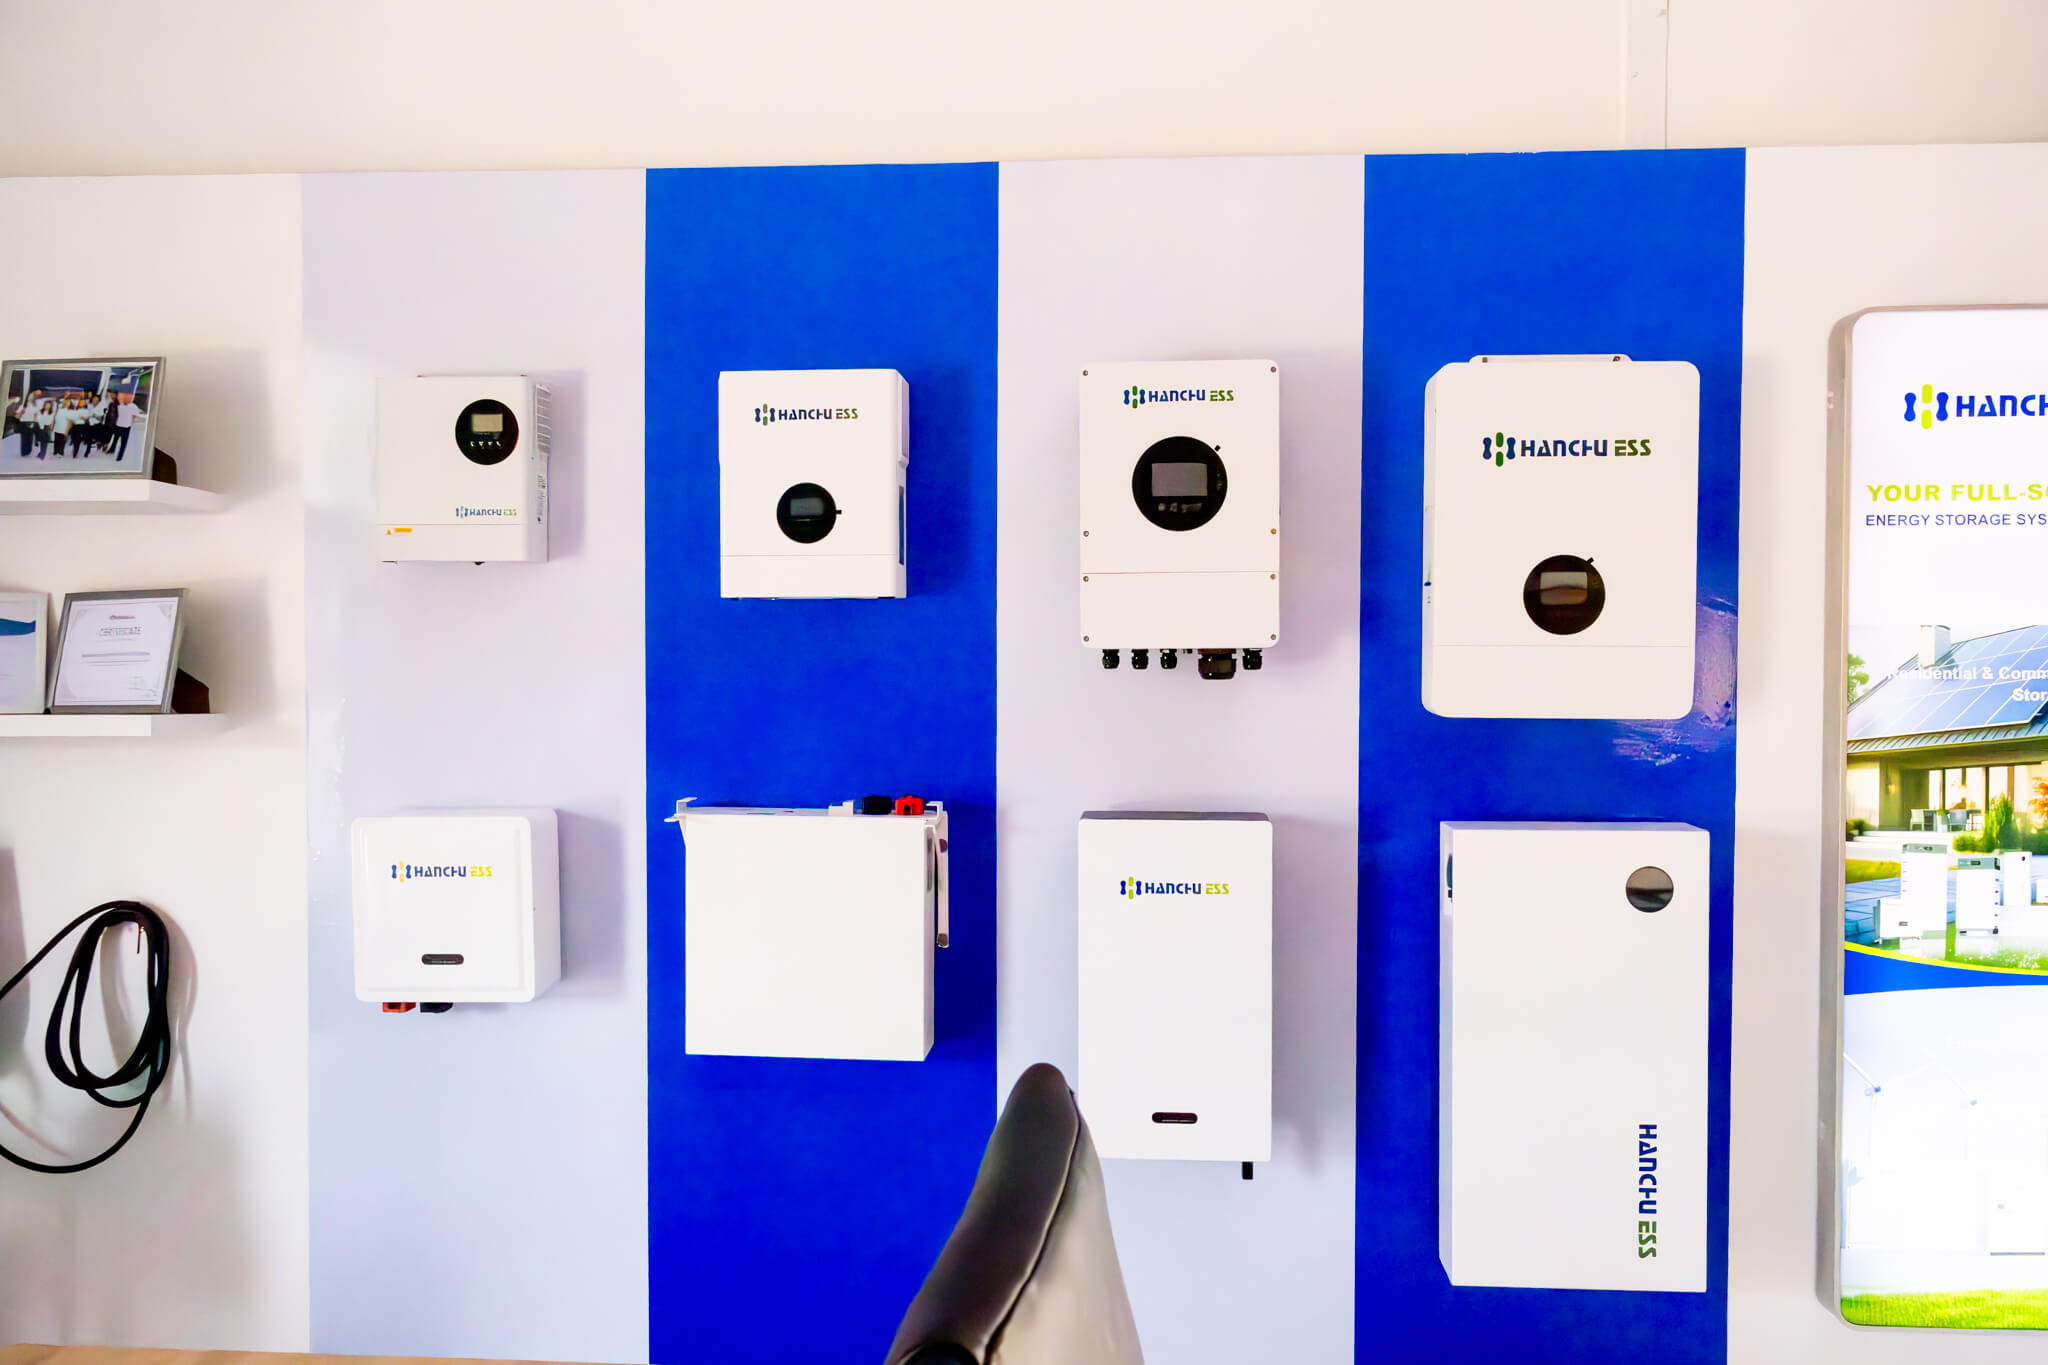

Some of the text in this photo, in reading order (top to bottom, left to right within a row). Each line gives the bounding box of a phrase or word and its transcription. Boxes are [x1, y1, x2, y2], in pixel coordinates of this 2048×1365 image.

[1148, 389, 1234, 402] HANCHU ESS
[779, 408, 858, 420] HANCHU ESS
[1521, 439, 1651, 457] HANCHU ESS
[1868, 484, 2048, 502] YOUR FULL-S
[1866, 514, 2047, 526] ENERGY STORAGE SYS
[1982, 667, 1994, 680] &
[414, 866, 492, 877] HANCHU ESS
[1145, 882, 1229, 895] HANCHU ESS
[1638, 1124, 1657, 1259] HANCHU ESS
